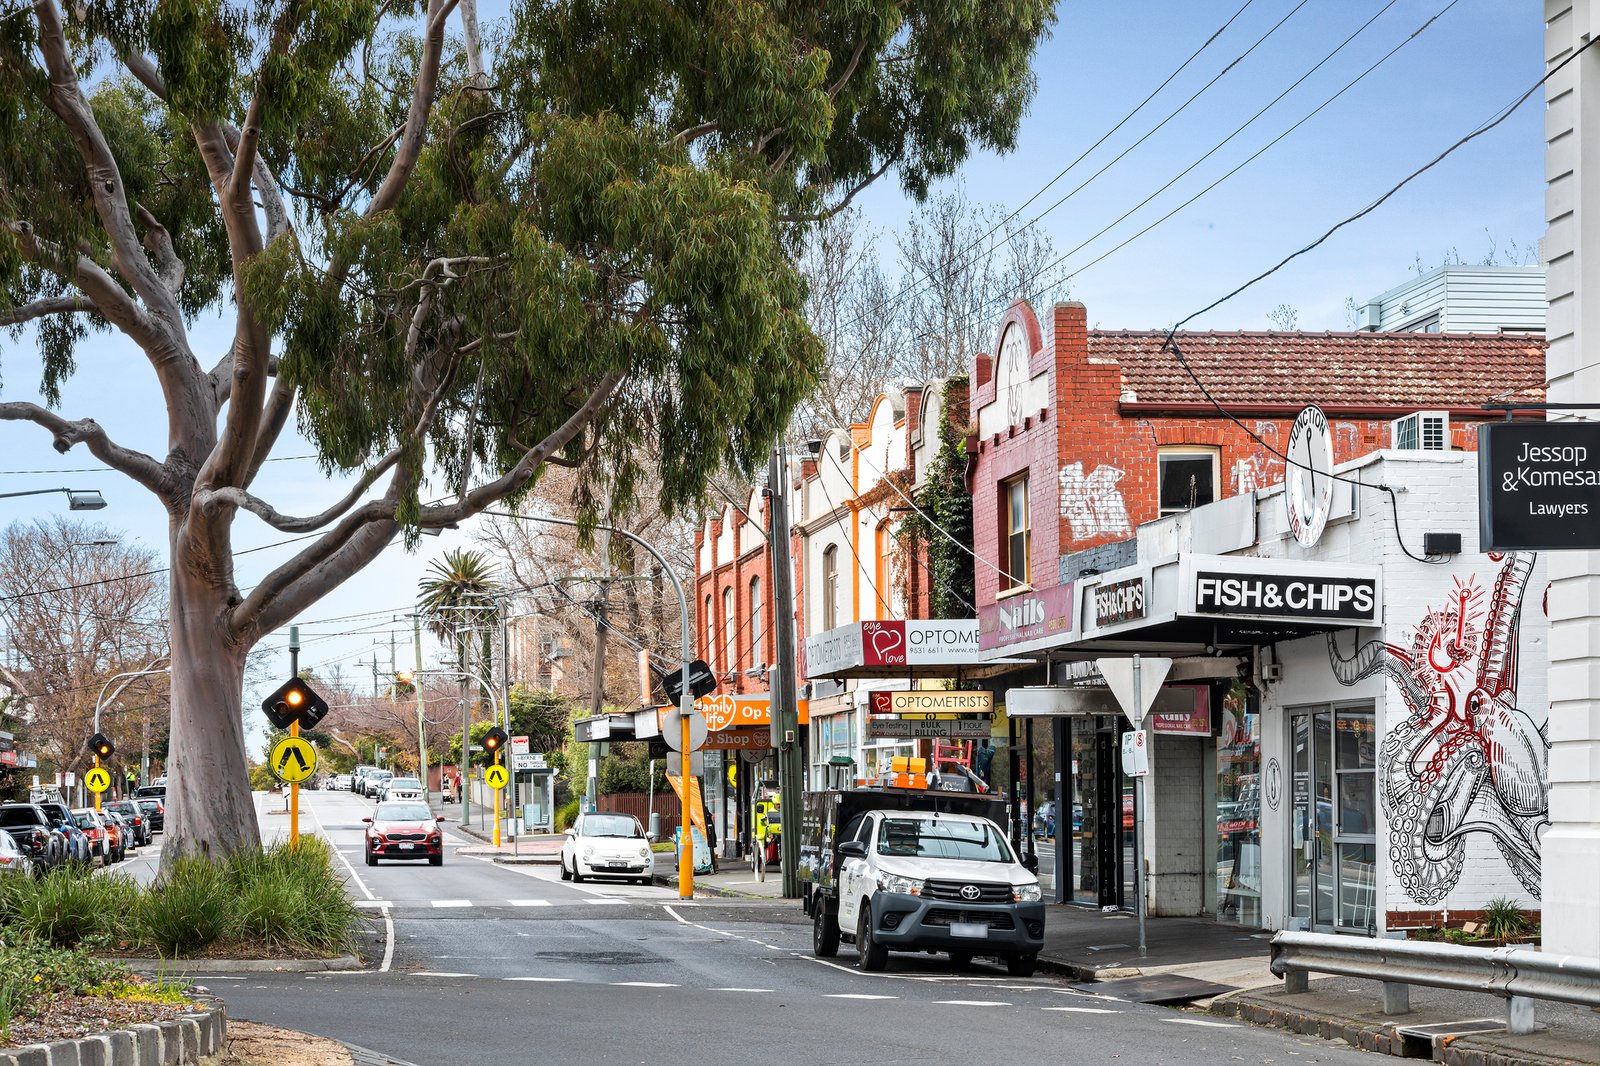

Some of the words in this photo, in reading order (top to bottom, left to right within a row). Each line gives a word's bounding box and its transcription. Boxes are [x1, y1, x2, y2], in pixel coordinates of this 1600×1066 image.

[1292, 408, 1325, 449] JUNCTION
[1517, 442, 1587, 466] Jessop
[1530, 501, 1588, 517] Lawyers
[999, 598, 1045, 631] Nails
[863, 622, 881, 634] eye
[999, 631, 1024, 643] PROFESSIONAL
[885, 652, 904, 663] love
[696, 700, 732, 715] family
[895, 696, 989, 708] OPTOMETRISTS
[742, 706, 762, 719] Op
[872, 721, 884, 731] Eye
[885, 721, 908, 730] Testing
[920, 721, 941, 729] BULK
[958, 721, 962, 731] 1
[964, 721, 982, 729] hour
[915, 729, 947, 737] BILLING
[716, 733, 749, 746] Shop
